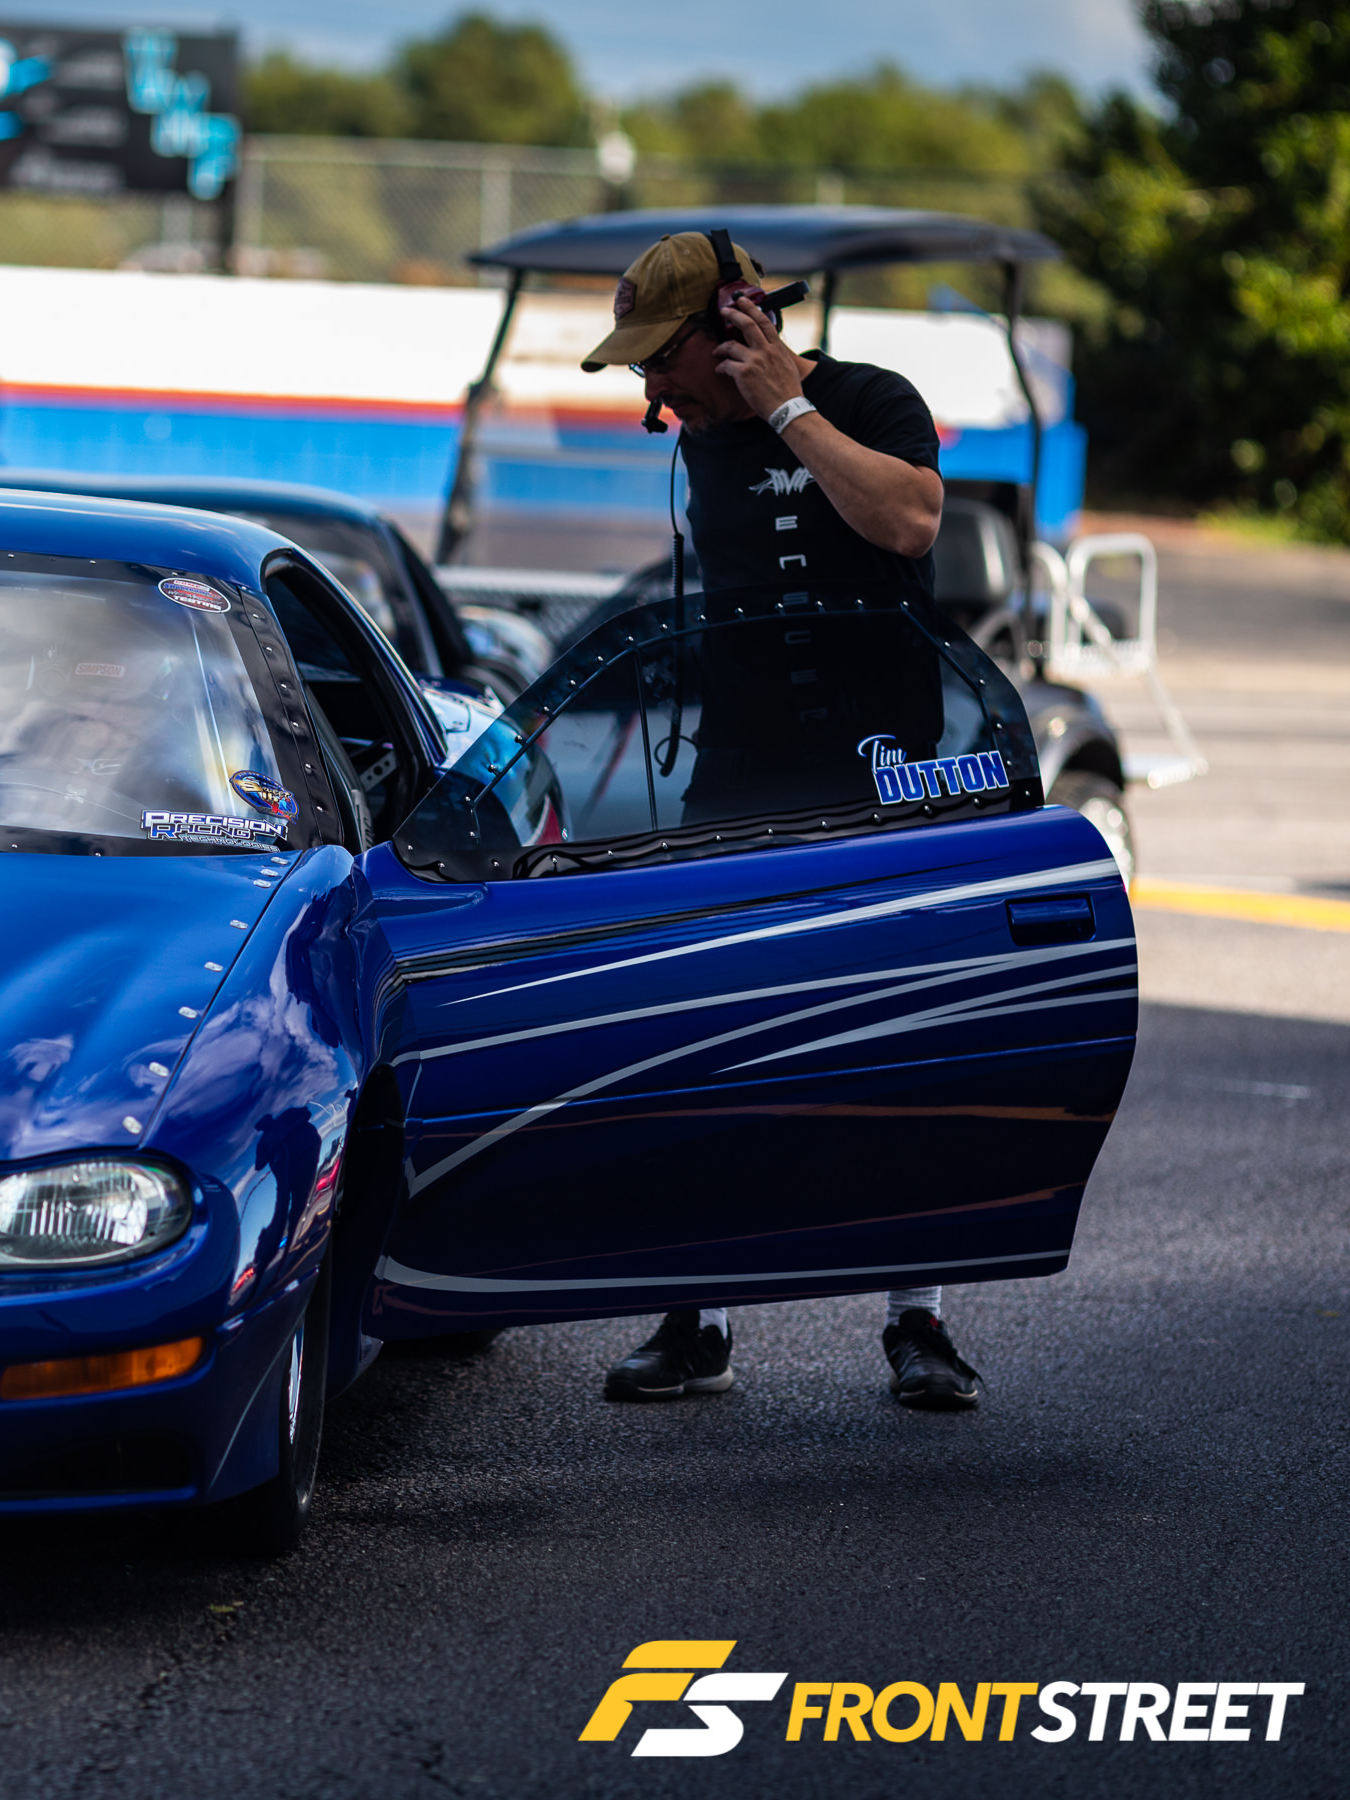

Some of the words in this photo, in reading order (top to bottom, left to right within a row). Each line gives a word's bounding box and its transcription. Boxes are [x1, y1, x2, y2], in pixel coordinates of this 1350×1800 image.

[77, 663, 123, 676] SIMPSON
[857, 734, 907, 774] Tim
[873, 750, 1010, 806] DUTTON
[142, 810, 285, 837] PRECISION
[150, 822, 252, 839] RACING
